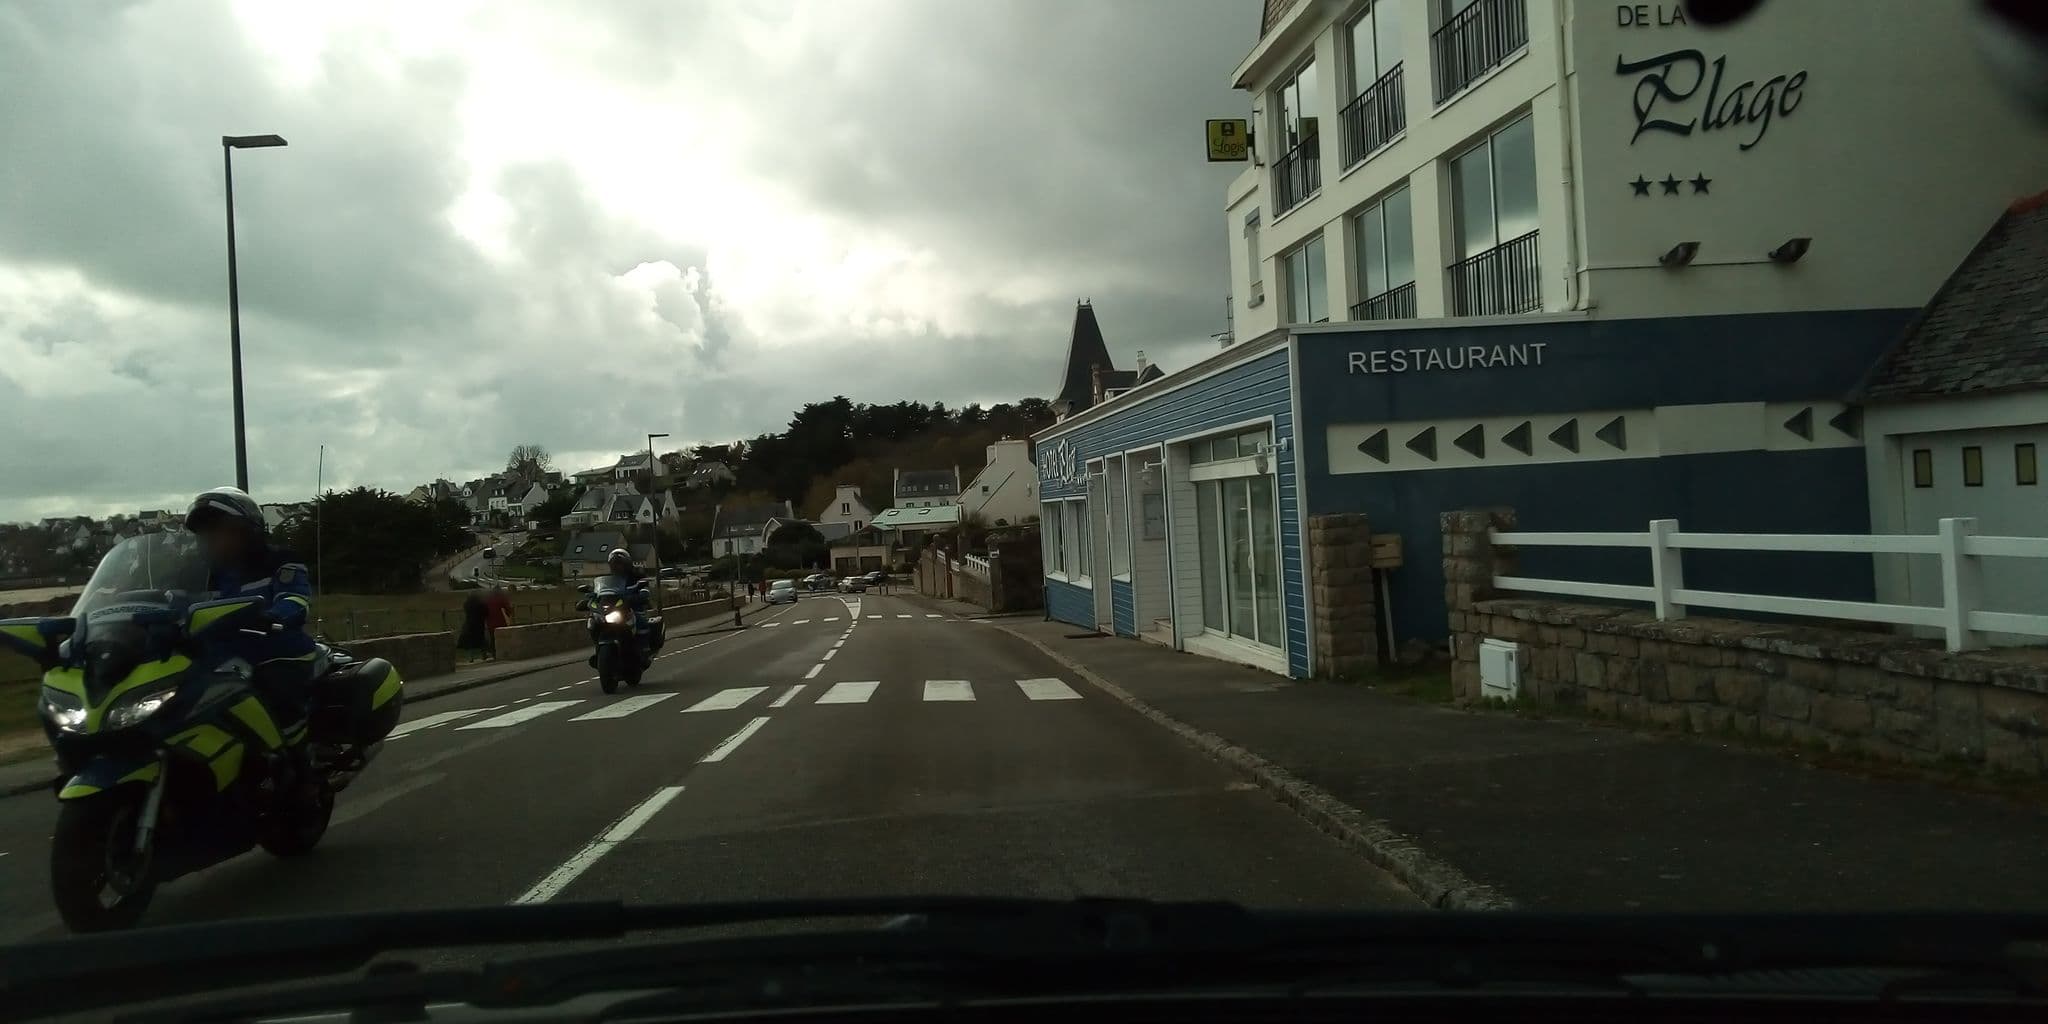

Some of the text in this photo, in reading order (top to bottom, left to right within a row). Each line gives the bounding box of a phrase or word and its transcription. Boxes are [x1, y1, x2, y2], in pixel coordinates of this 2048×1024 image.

[1617, 4, 1687, 27] DE LA
[1616, 49, 1808, 151] Plage
[1213, 137, 1246, 157] Logis
[1349, 343, 1547, 374] RESTAURANT
